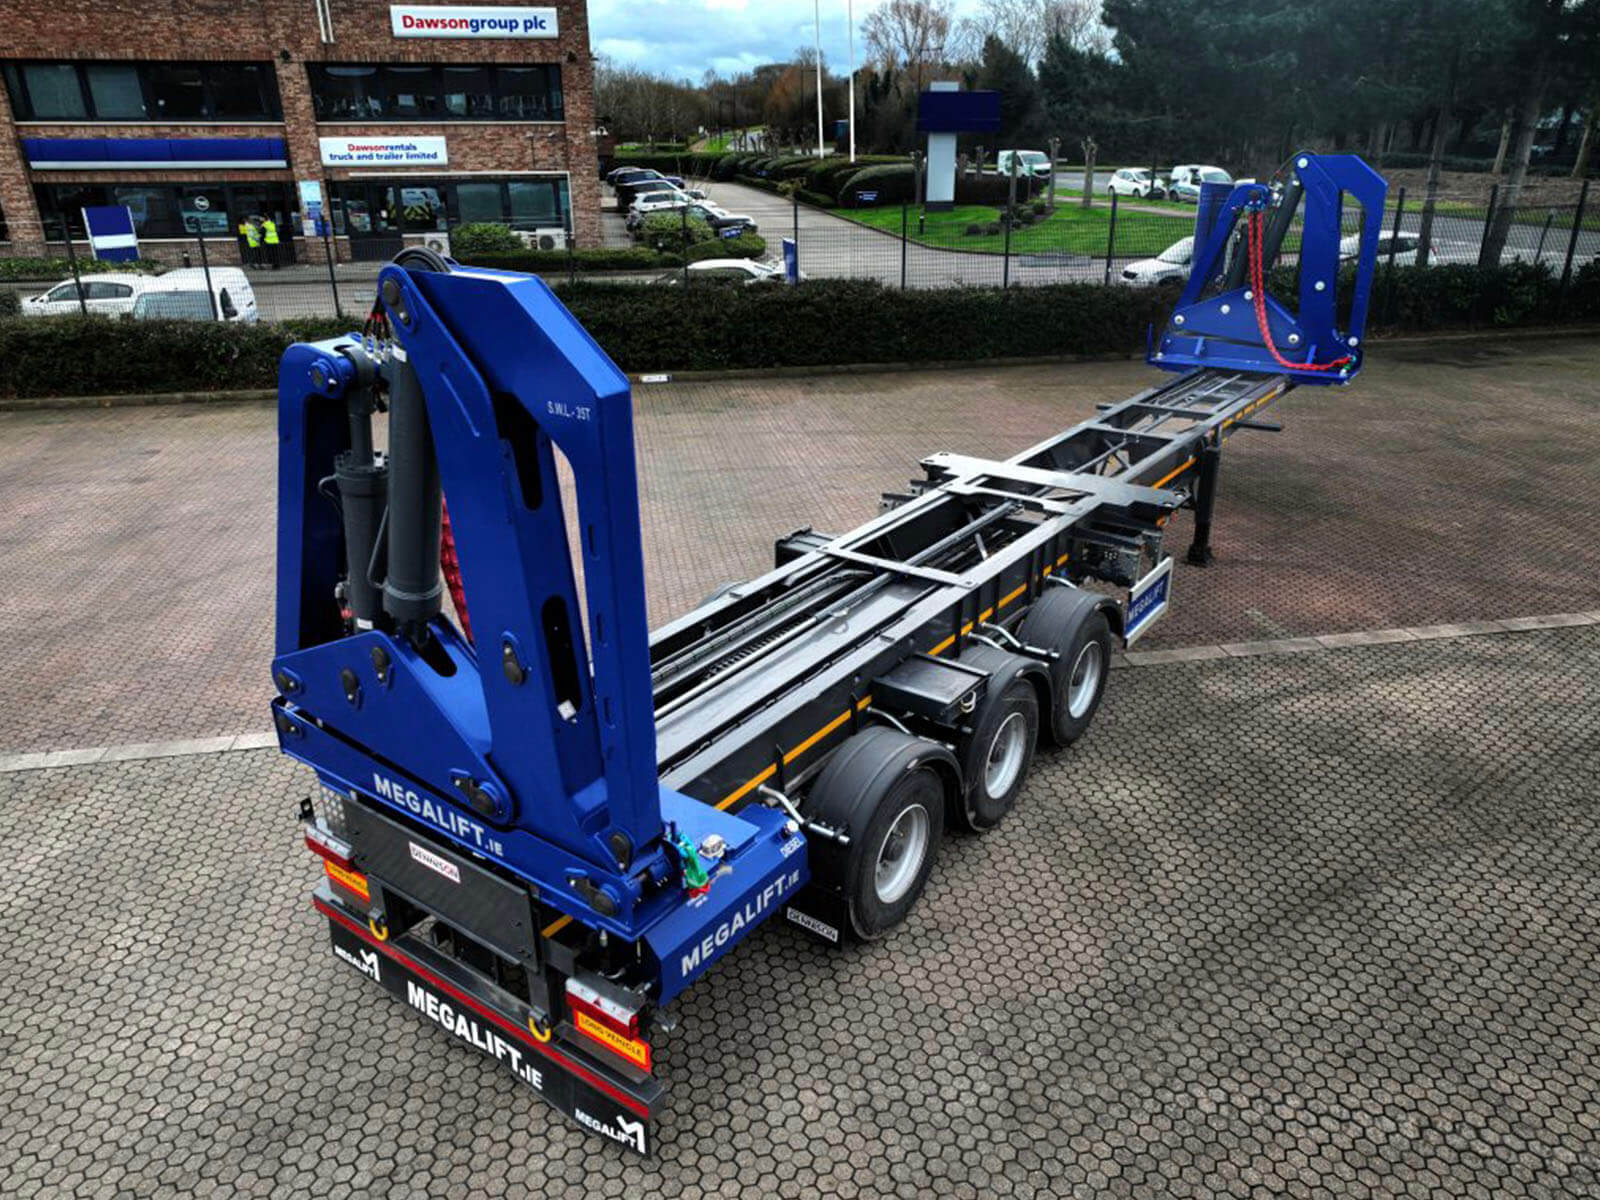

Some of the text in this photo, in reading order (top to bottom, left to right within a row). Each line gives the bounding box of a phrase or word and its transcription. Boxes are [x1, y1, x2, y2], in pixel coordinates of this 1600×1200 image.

[402, 15, 546, 32] Dawsongroup plc
[329, 151, 438, 160] truck and trailer limited
[347, 143, 417, 152] Dawsonrentals
[373, 772, 504, 857] MEGALIFT.IE
[681, 869, 800, 977] MEGALIFT.IE
[407, 980, 543, 1090] MEGALIFT.IE
[575, 1107, 637, 1148] MEGALIFT
